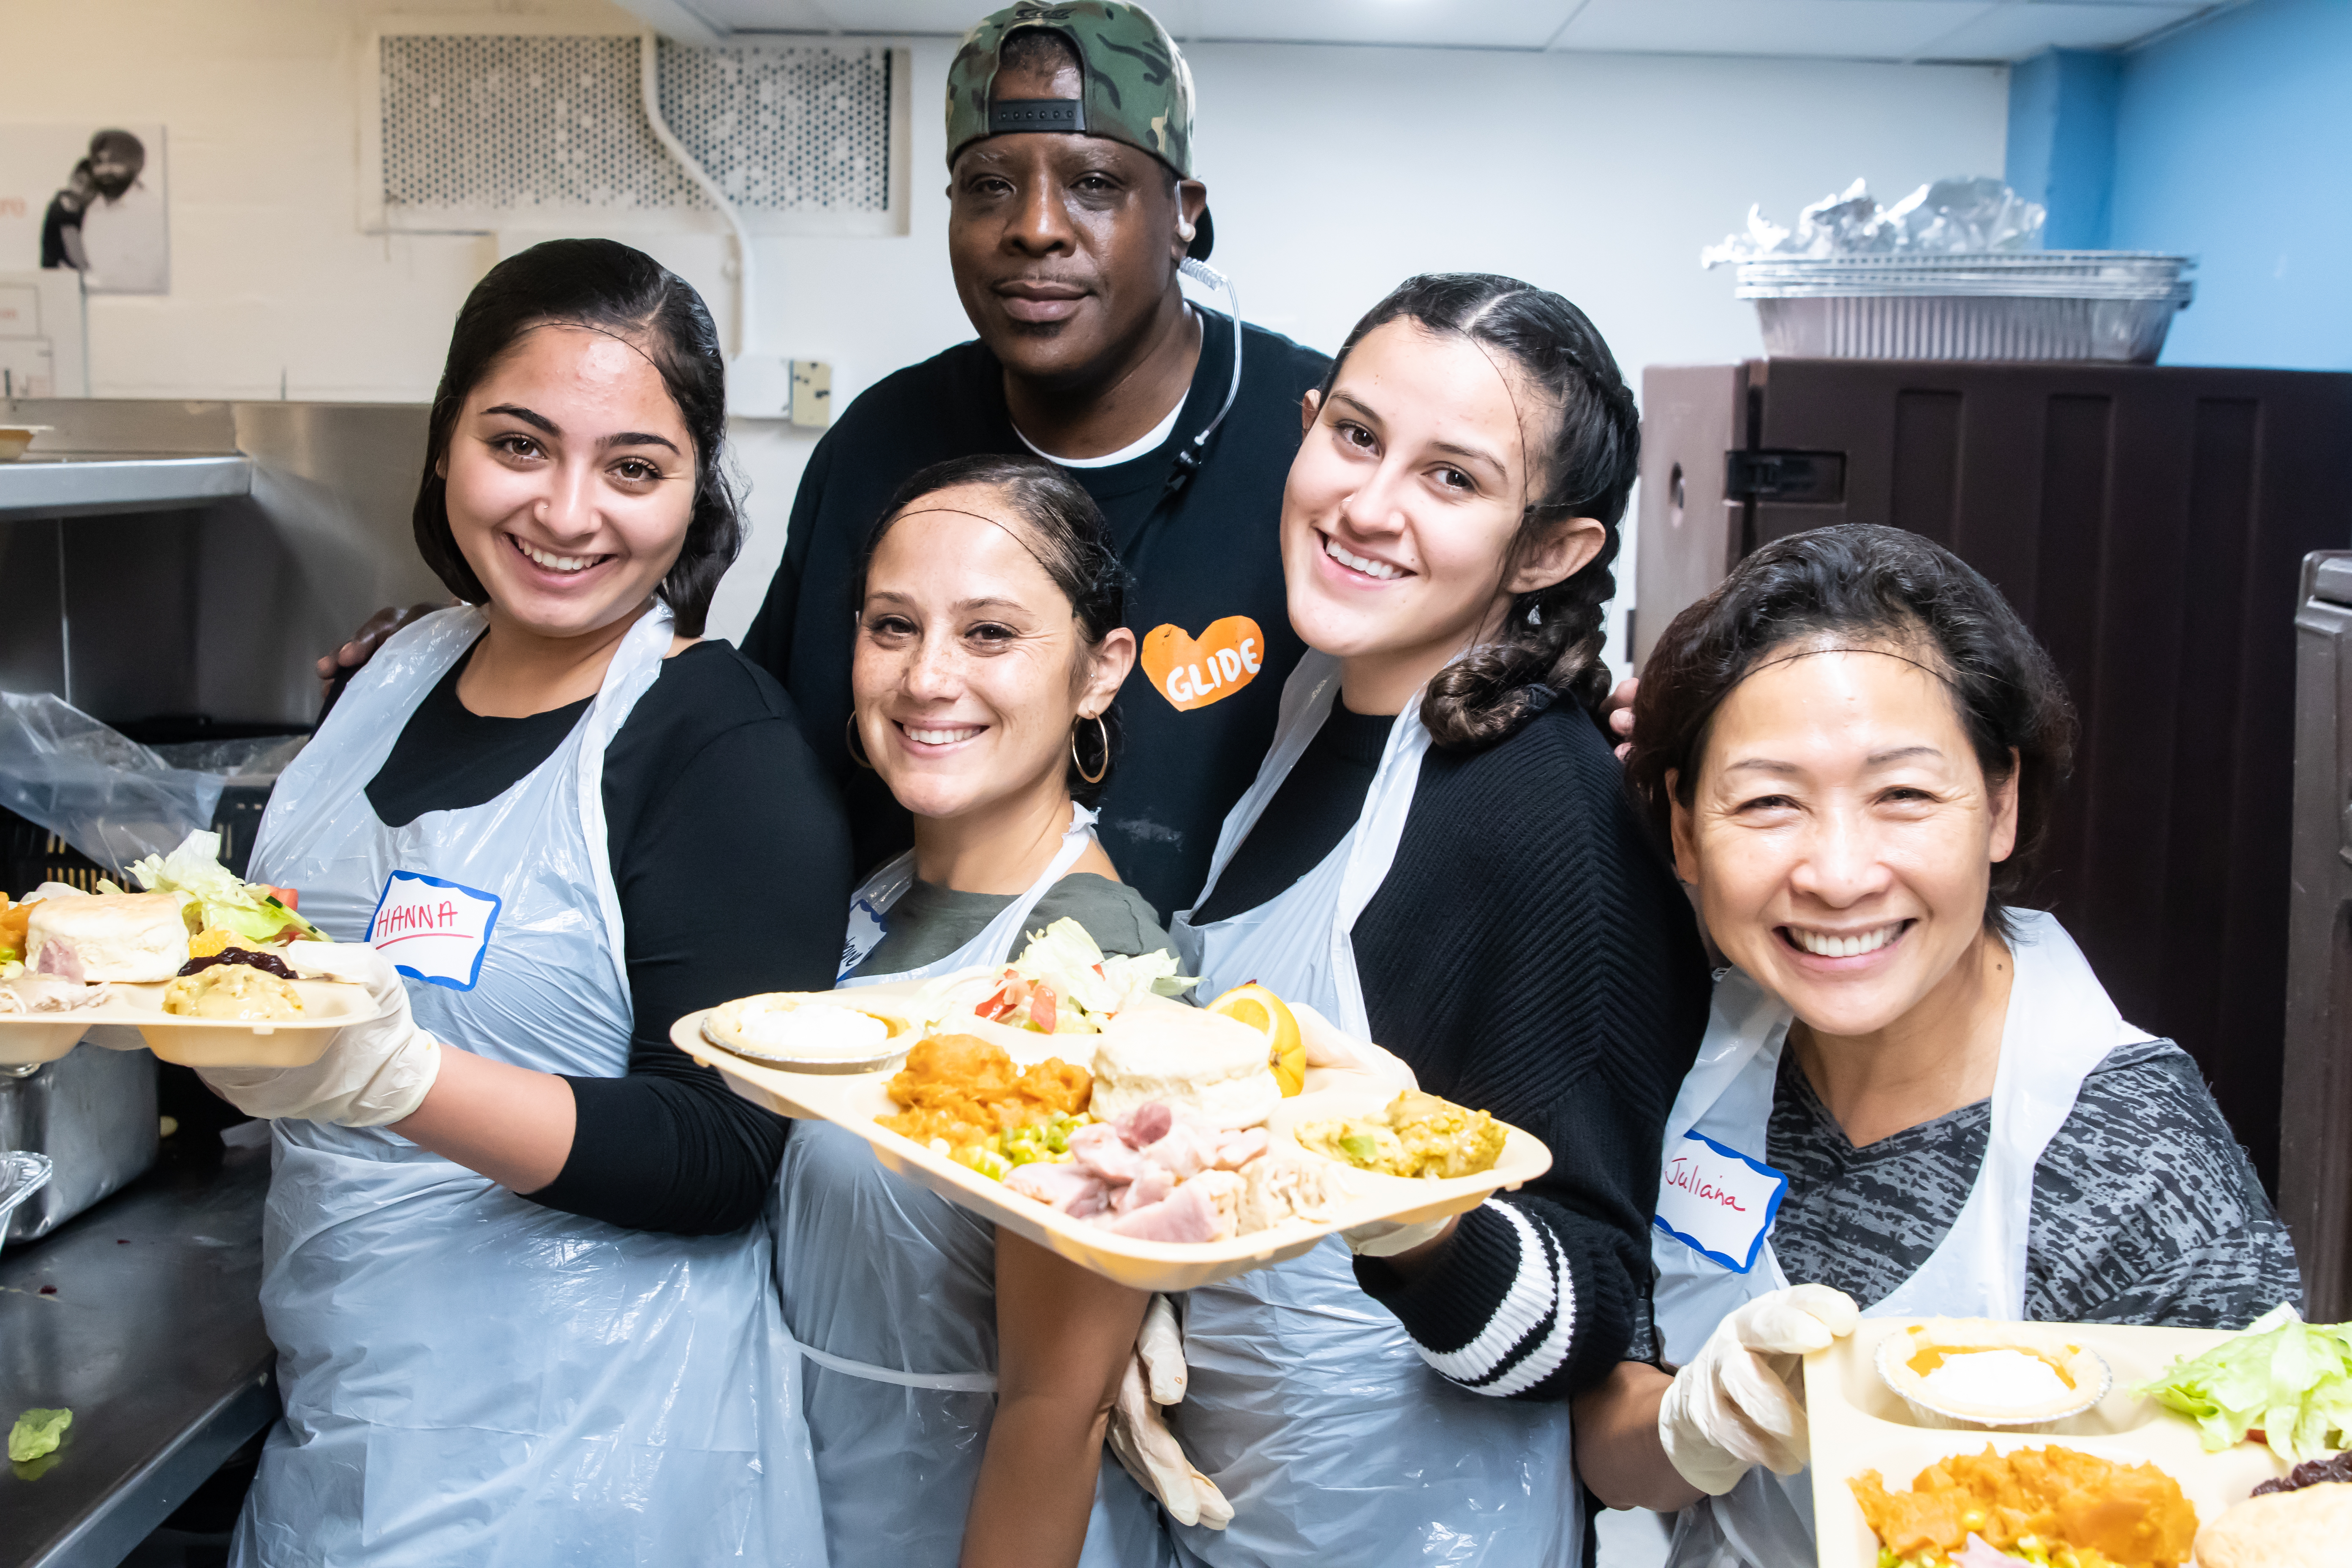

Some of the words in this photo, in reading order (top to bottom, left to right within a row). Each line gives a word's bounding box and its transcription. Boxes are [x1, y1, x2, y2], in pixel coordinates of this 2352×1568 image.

[1166, 637, 1260, 702] GLIDE
[376, 901, 458, 937] HANNA
[1665, 1157, 1746, 1211] Juliana
